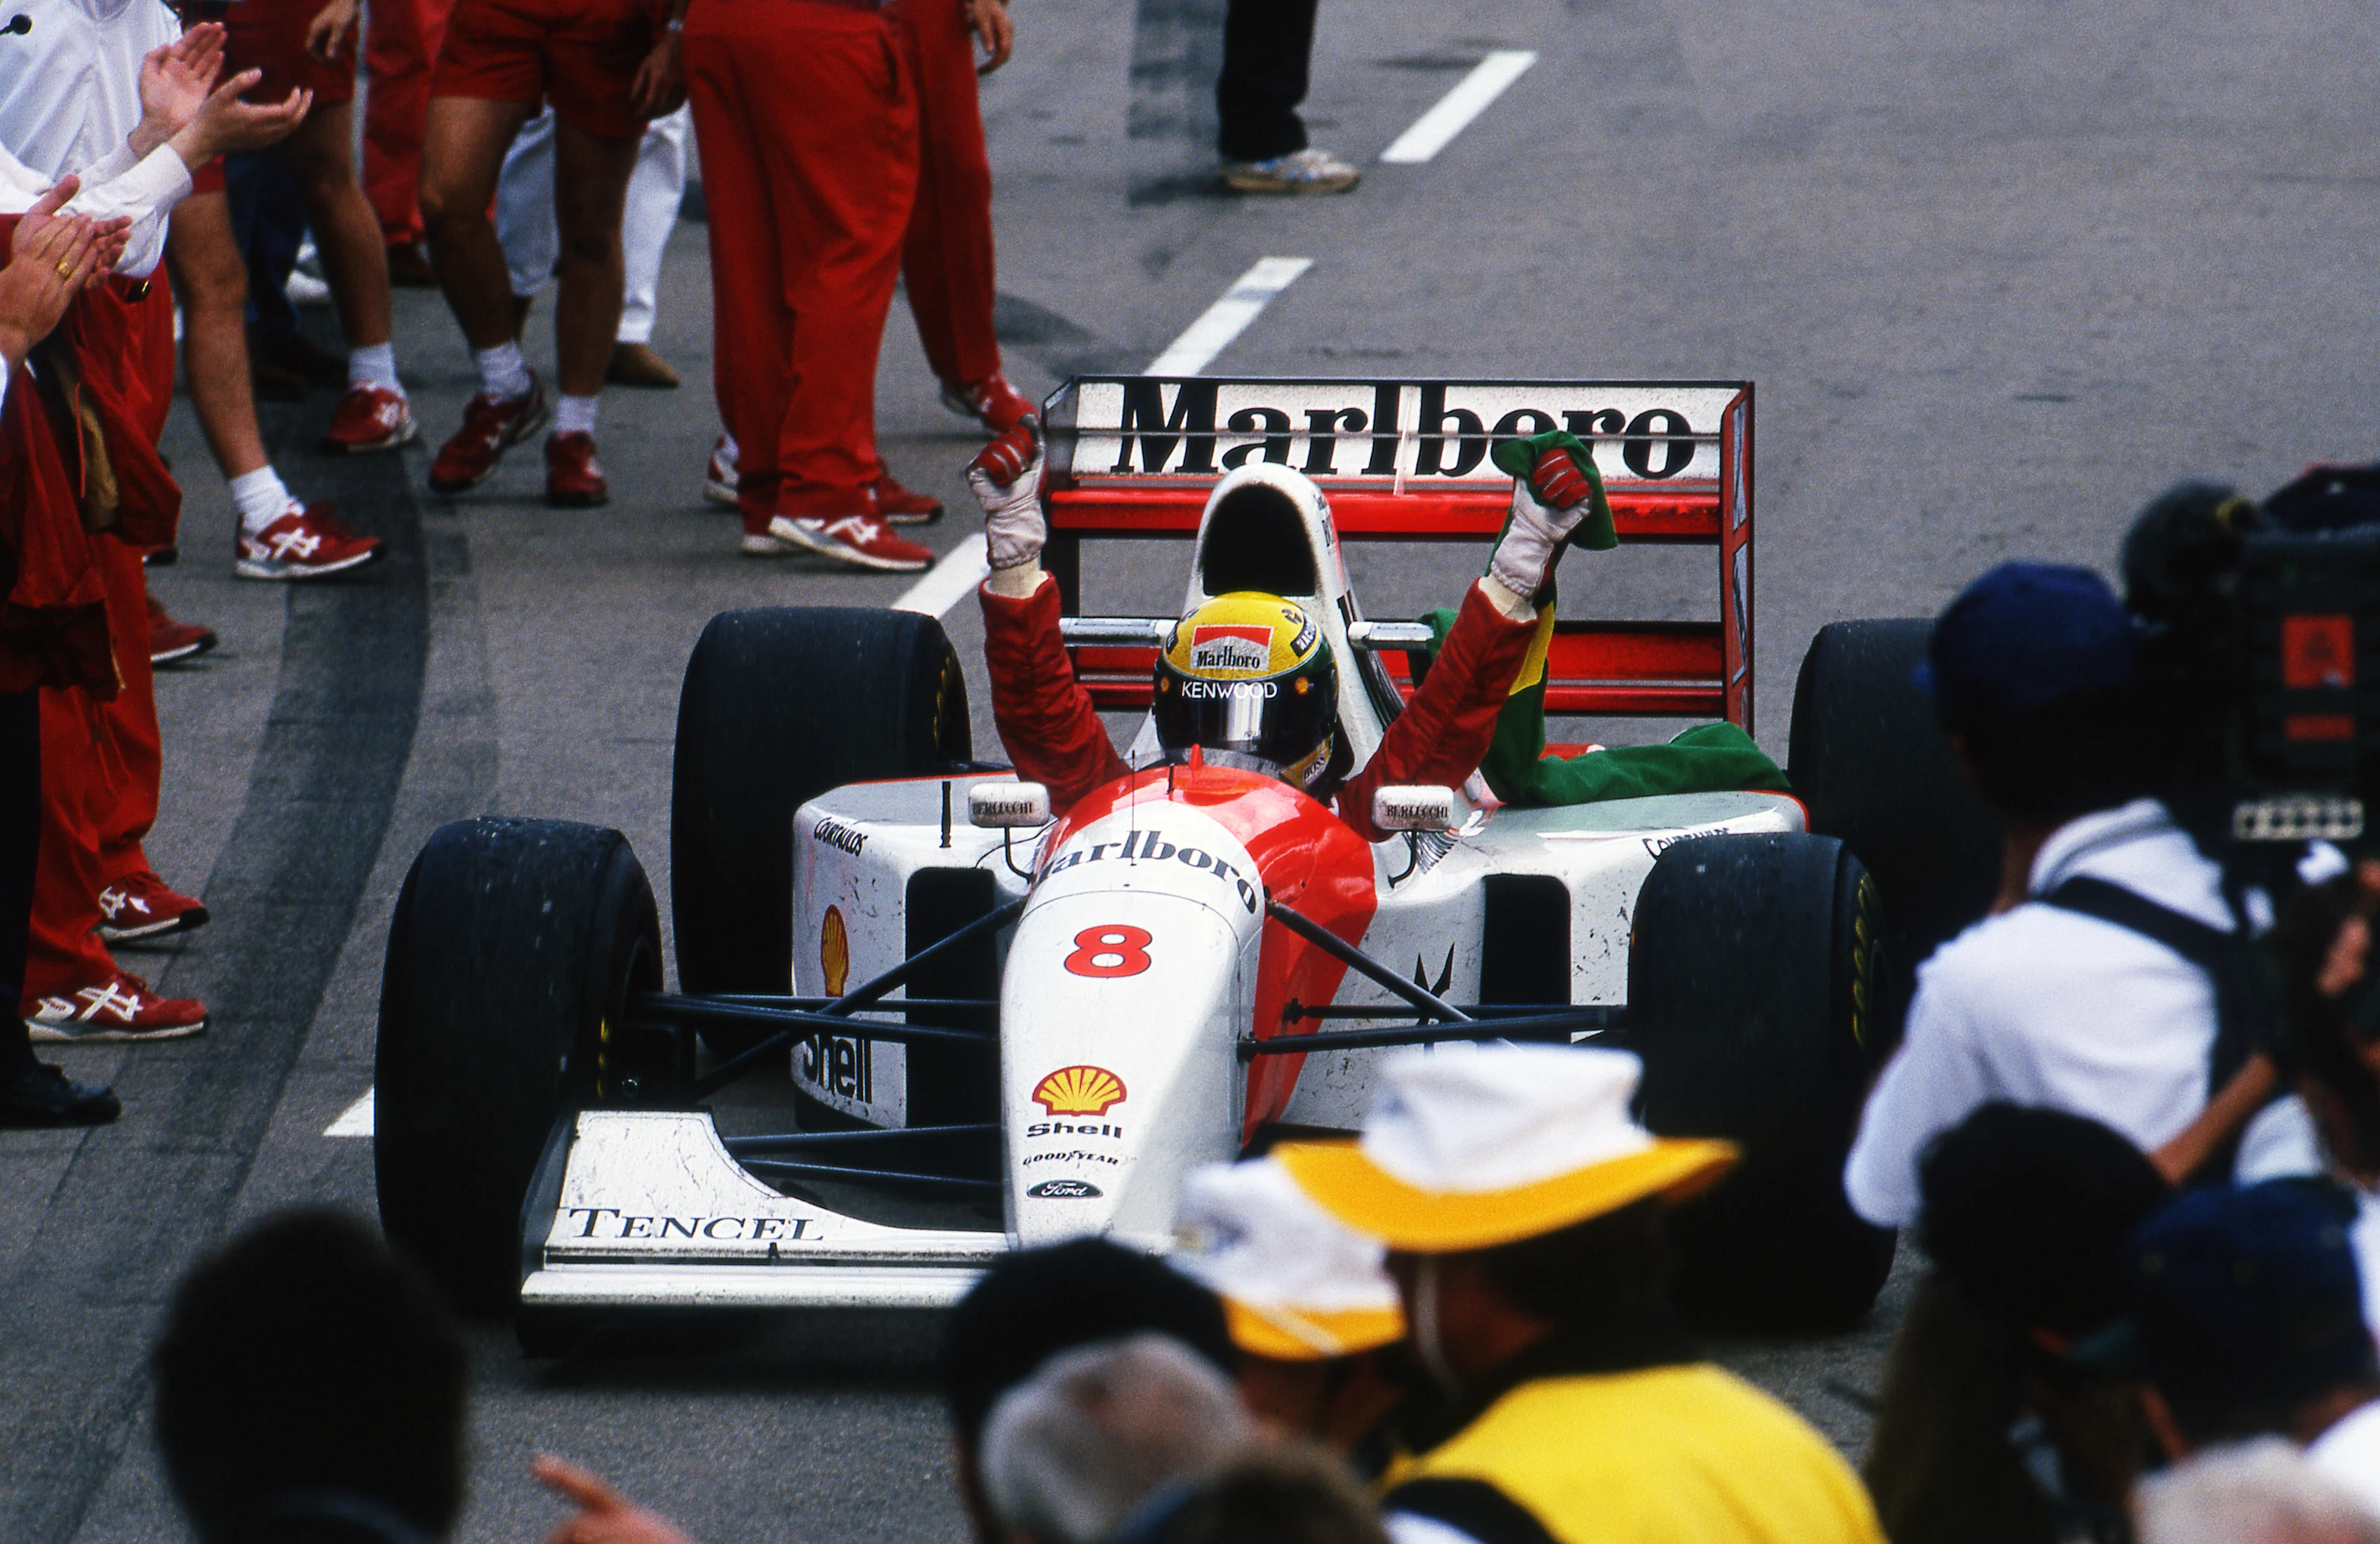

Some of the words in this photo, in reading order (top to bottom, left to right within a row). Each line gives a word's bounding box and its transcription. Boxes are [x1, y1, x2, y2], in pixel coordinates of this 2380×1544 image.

[1111, 381, 1695, 480] Marlboro
[1196, 646, 1261, 669] Marlboro
[1182, 681, 1278, 699] KENWOOD
[1037, 829, 1257, 914] arlboro
[1064, 924, 1153, 979] 8
[802, 1033, 872, 1105] Shell
[1027, 1122, 1123, 1139] Shell
[1023, 1150, 1119, 1166] GOODYEAR
[1041, 1182, 1088, 1197] Ford
[568, 1207, 824, 1241] TENCEL
